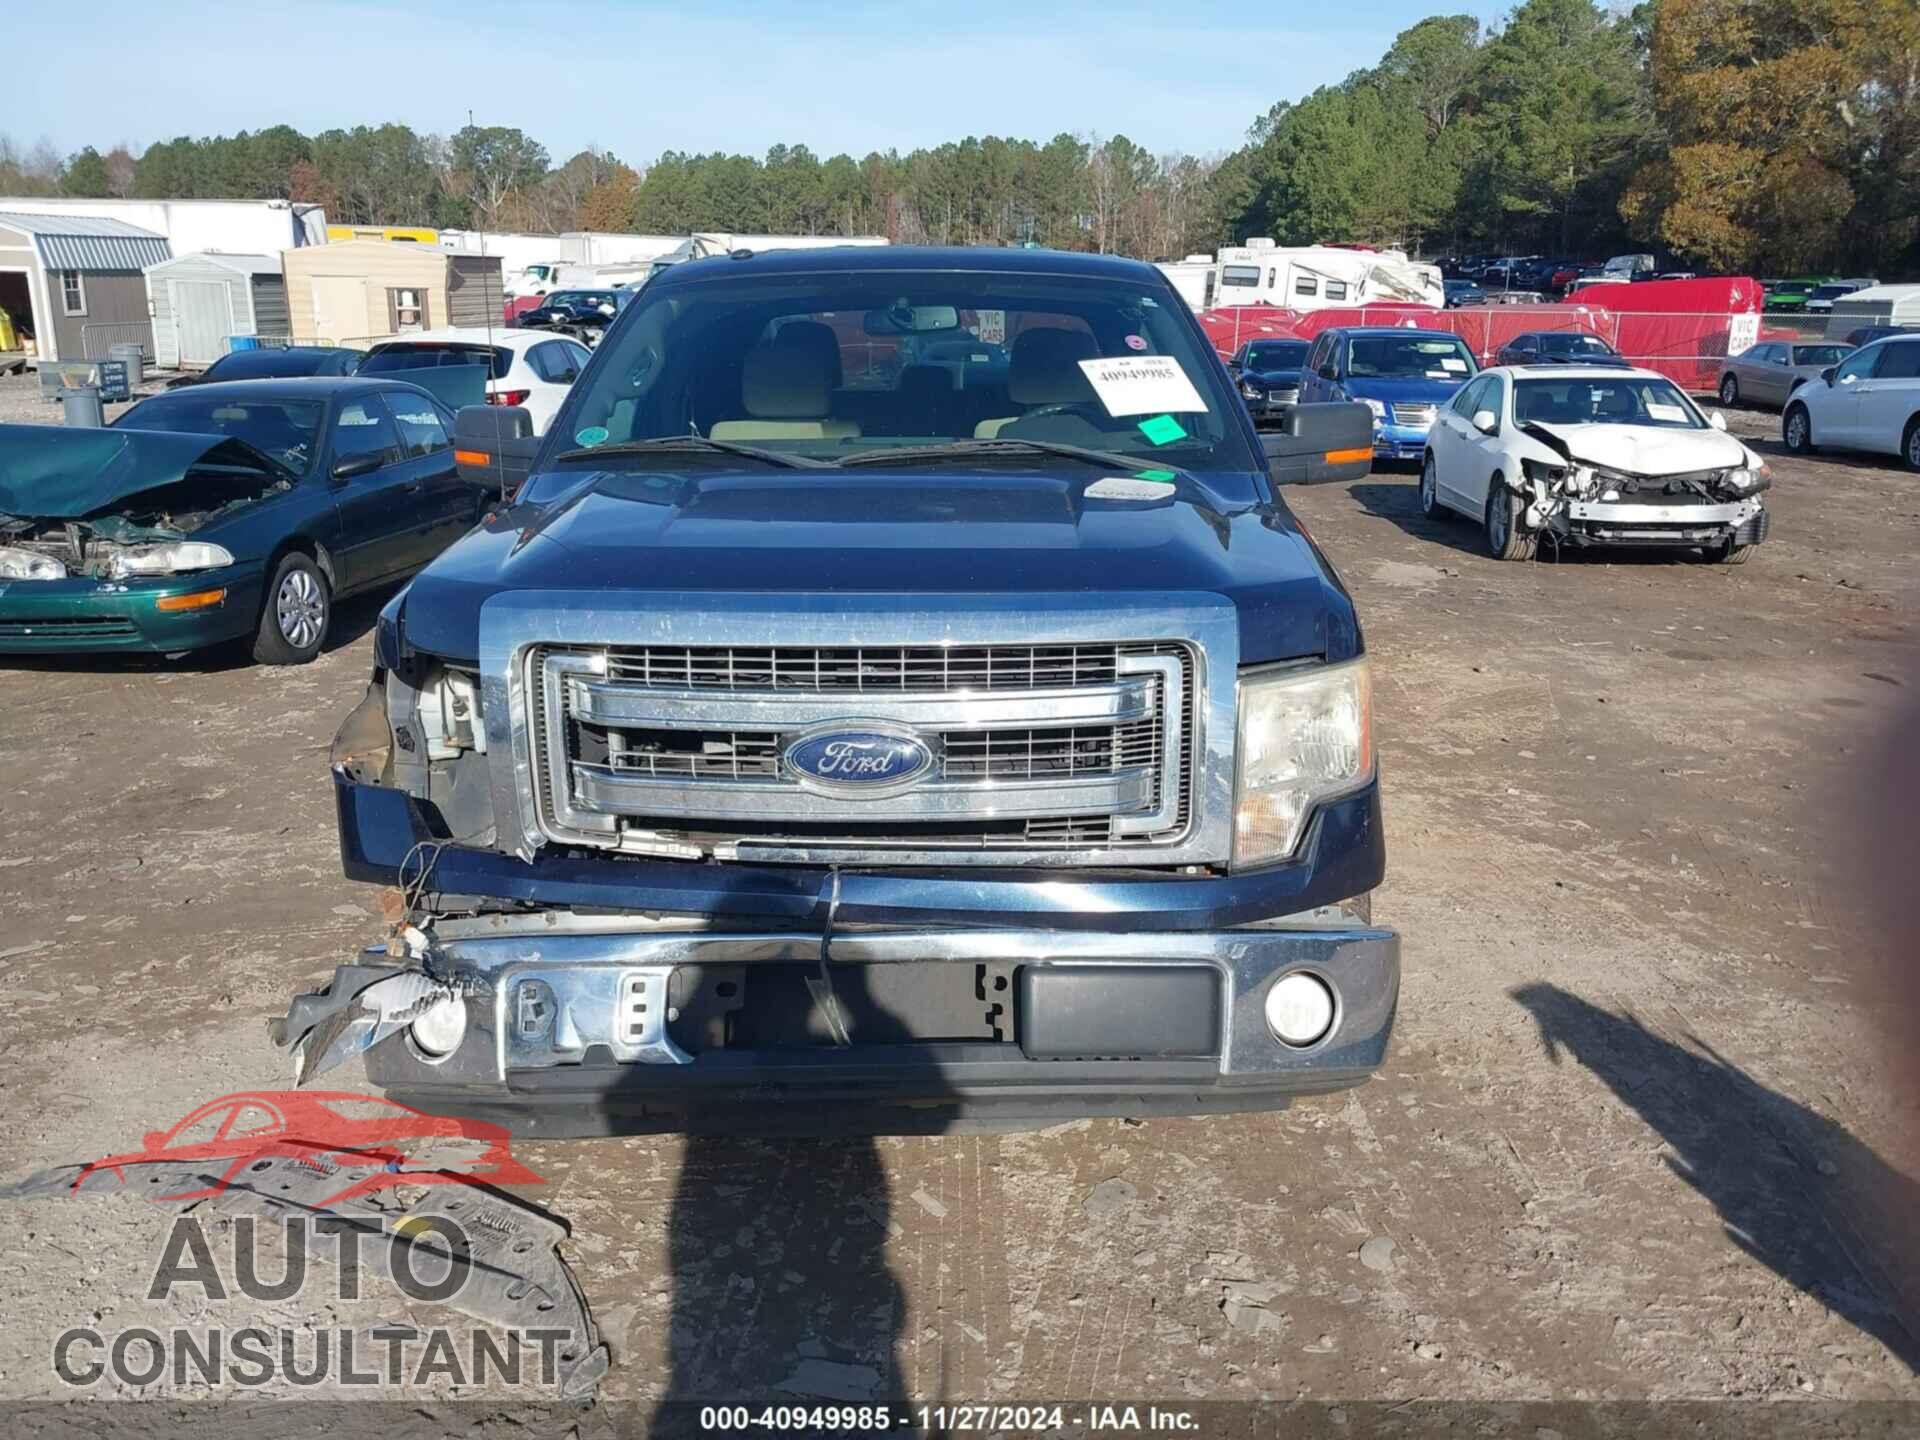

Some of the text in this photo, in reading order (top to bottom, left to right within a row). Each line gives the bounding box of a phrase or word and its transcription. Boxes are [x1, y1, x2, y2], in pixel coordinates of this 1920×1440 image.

[984, 312, 1001, 325] VIC
[1736, 319, 1753, 333] VIC
[981, 329, 1004, 342] CARS
[1099, 368, 1175, 382] 40949985
[818, 741, 894, 773] Ford
